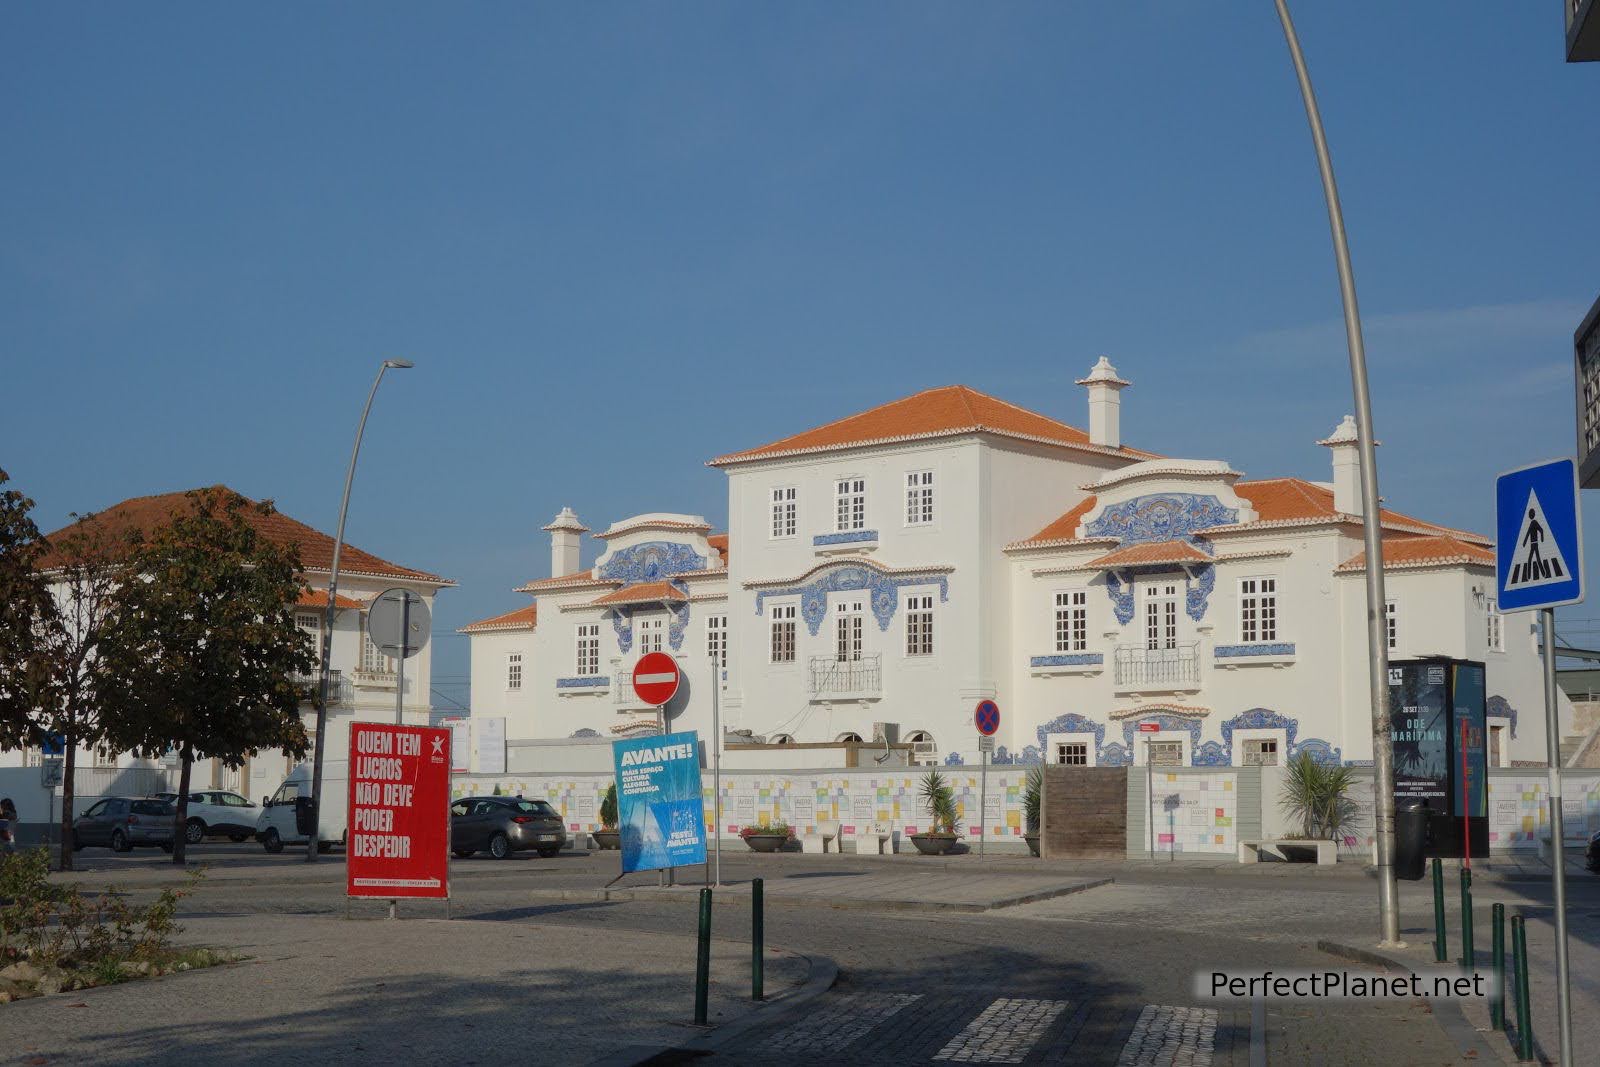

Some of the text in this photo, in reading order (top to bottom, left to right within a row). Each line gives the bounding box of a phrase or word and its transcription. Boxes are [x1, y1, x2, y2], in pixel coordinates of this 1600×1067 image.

[1407, 719, 1425, 728] ODE
[357, 730, 422, 756] QUEM TEM
[1391, 730, 1442, 741] MARÍTIMA
[621, 744, 693, 766] AVANTE!
[356, 756, 402, 780] LUCROS
[622, 774, 650, 782] CULTURA
[640, 766, 664, 774] ESPAÇO
[355, 782, 413, 806] NÃO DEVE
[623, 781, 650, 789] ALEGRIA
[355, 808, 393, 832] PODER
[354, 834, 410, 858] DESPEDIR
